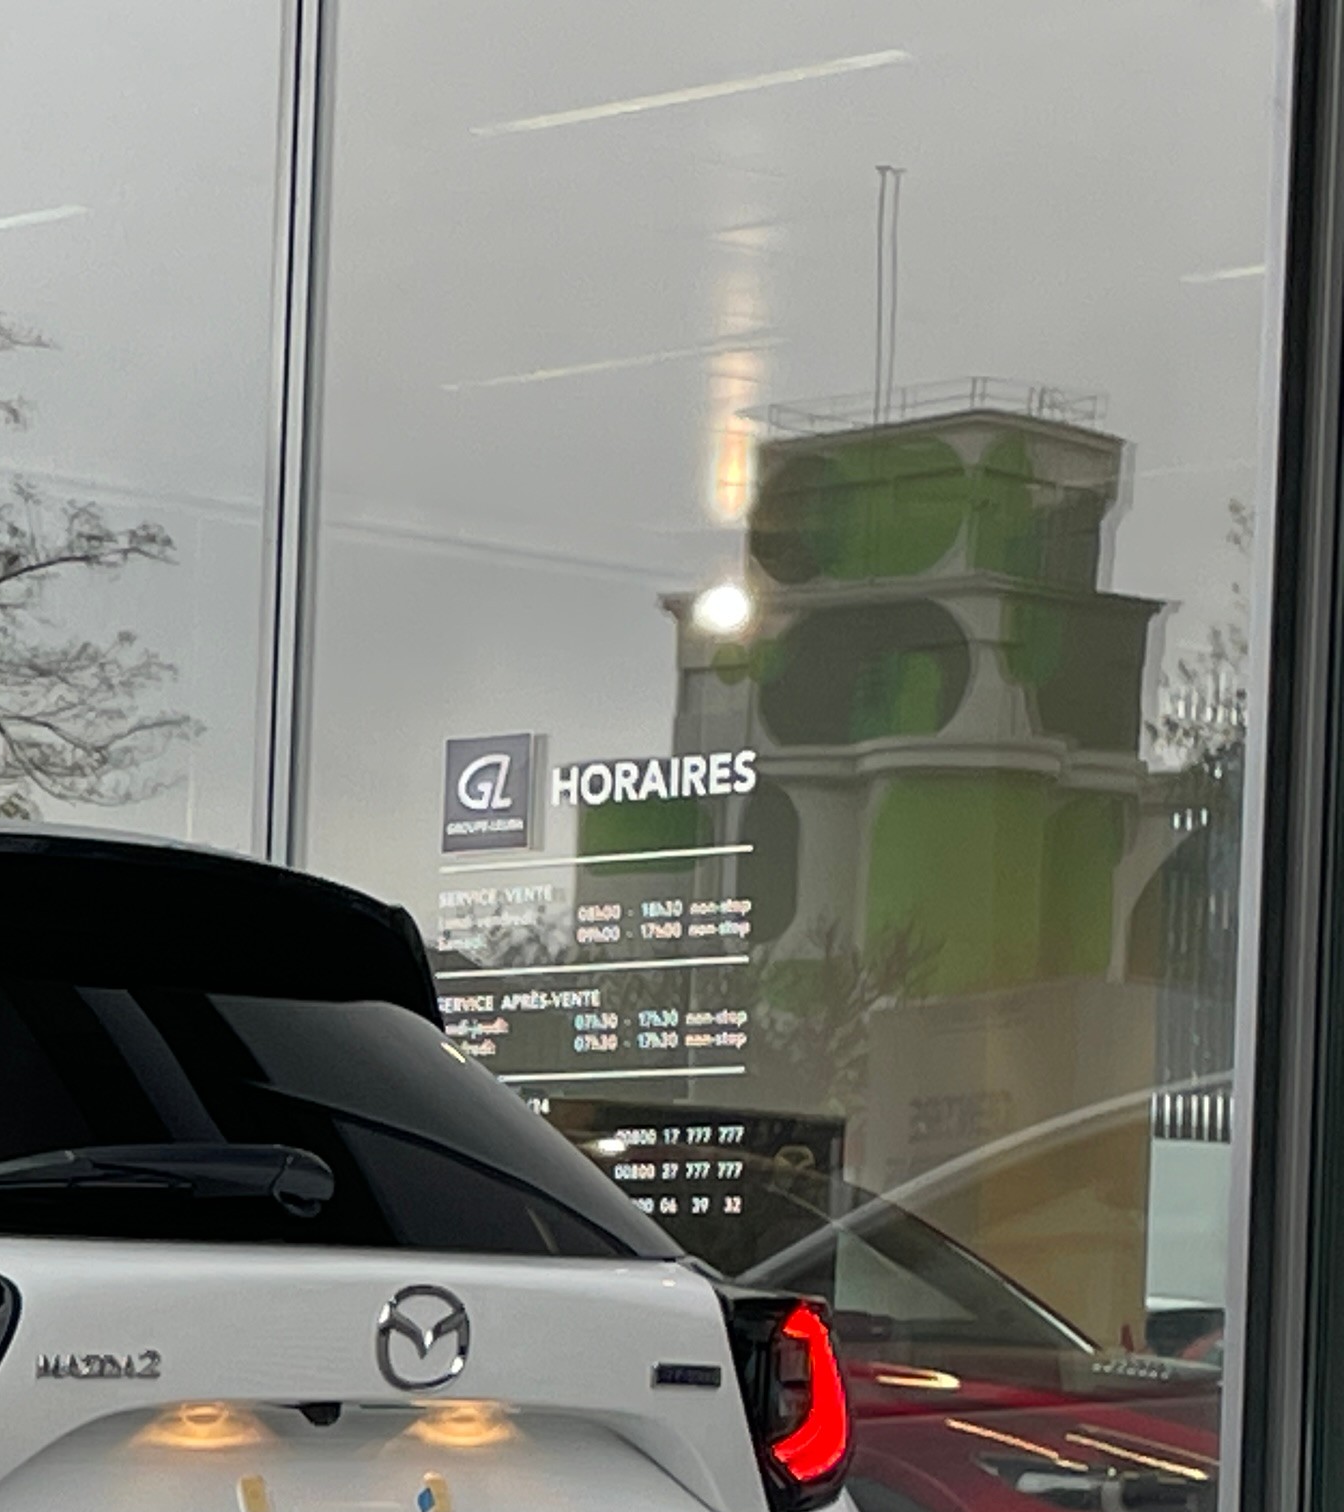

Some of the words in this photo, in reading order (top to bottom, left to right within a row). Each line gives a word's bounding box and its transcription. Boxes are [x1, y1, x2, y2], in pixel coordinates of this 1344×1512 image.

[549, 750, 757, 807] HORAIRES
[438, 887, 497, 908] SERVICE
[504, 883, 552, 904] VENTE
[663, 1127, 681, 1145] 17
[685, 1126, 712, 1145] 777
[718, 1125, 745, 1144] 777
[685, 1160, 711, 1180] 777
[717, 1160, 744, 1180] 777
